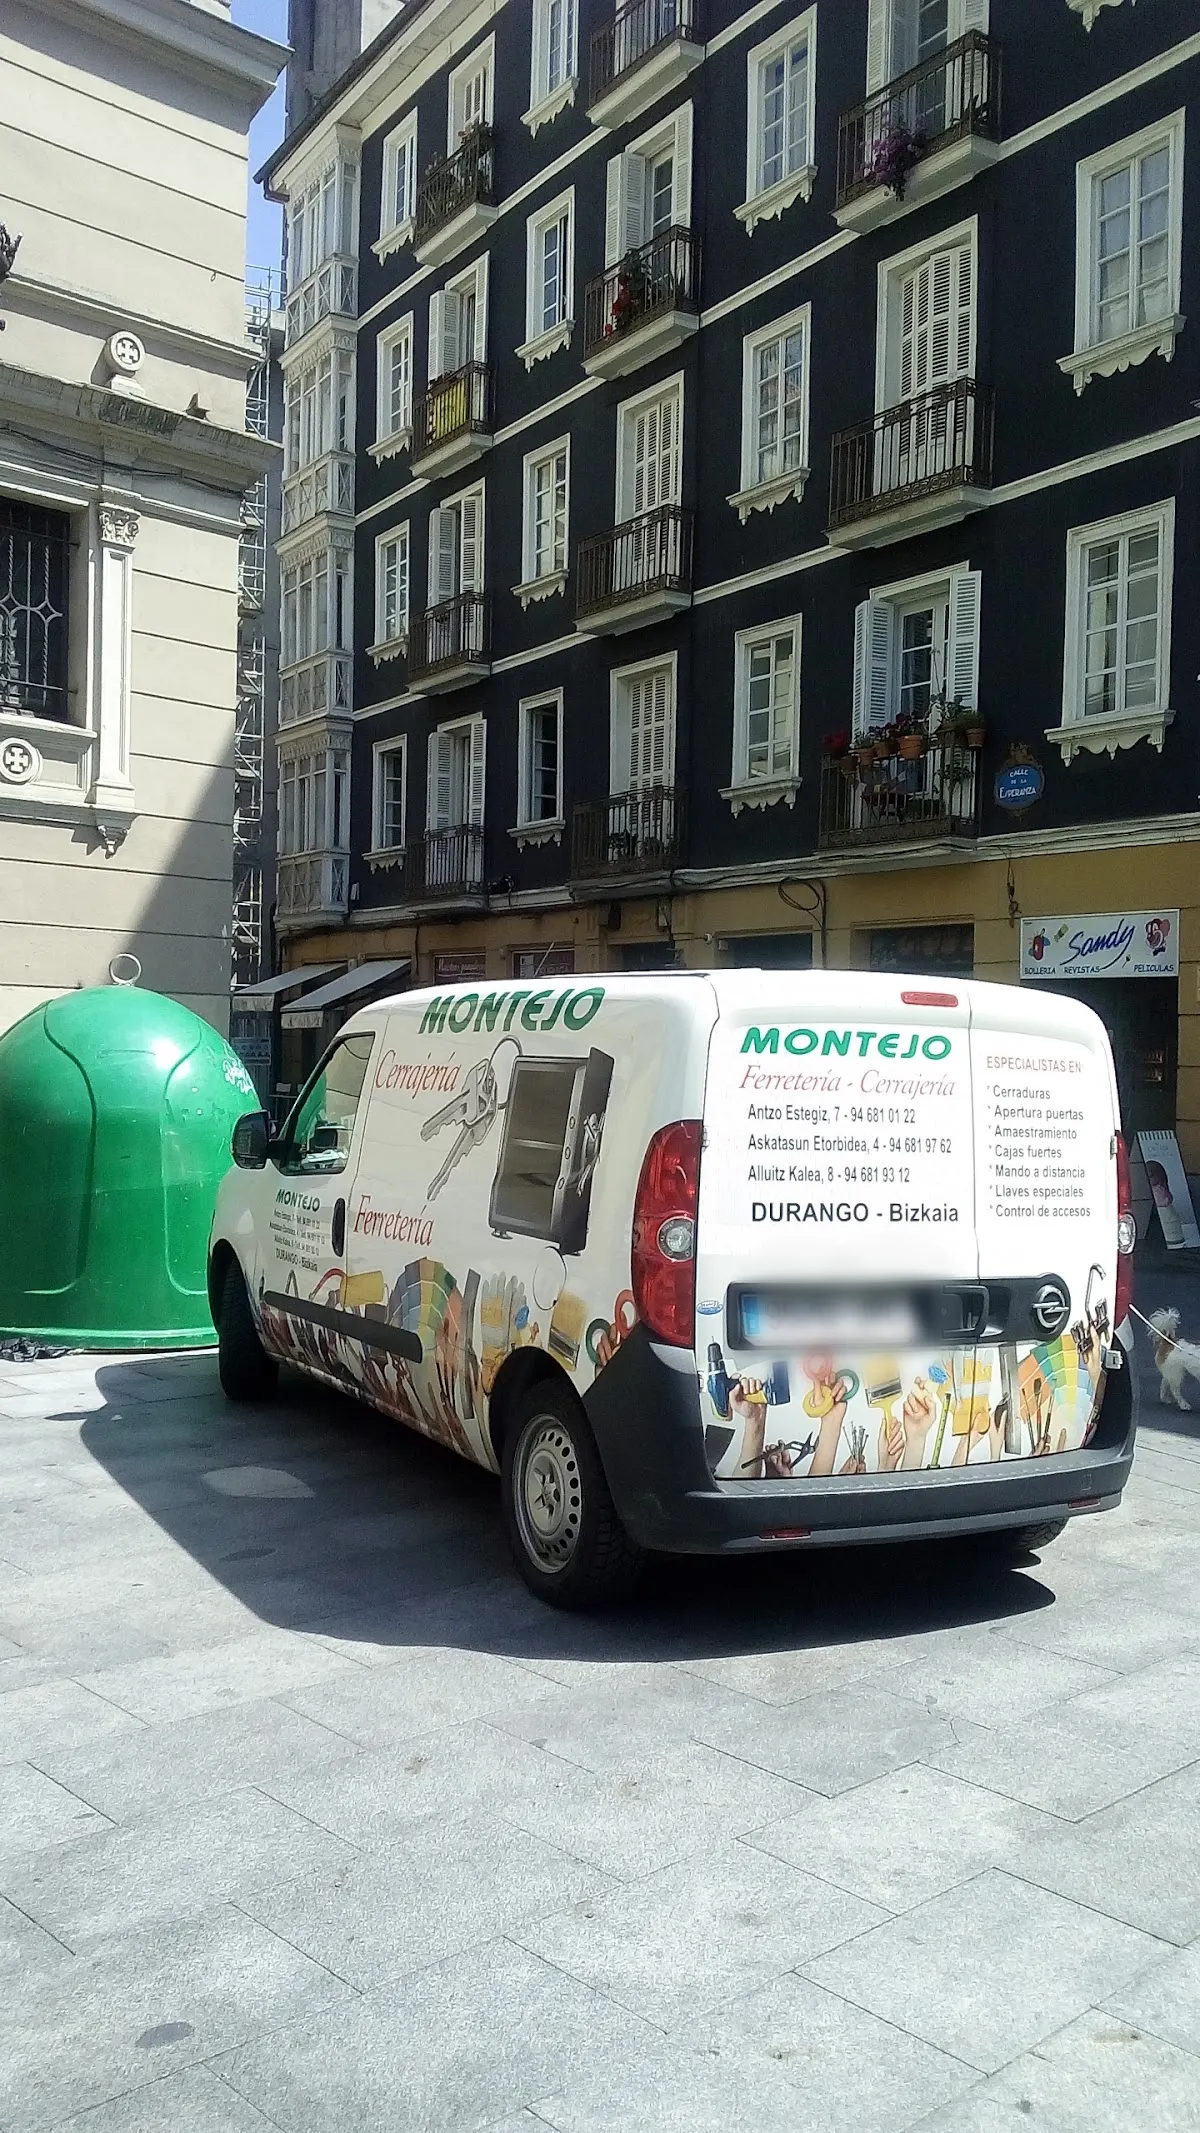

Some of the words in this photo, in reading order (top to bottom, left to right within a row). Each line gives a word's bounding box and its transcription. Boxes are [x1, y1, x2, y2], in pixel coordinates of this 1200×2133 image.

[1010, 769, 1028, 777] CALLE
[1000, 786, 1037, 799] ESPERANZA
[1060, 918, 1136, 970] Sandy
[1024, 967, 1056, 975] BOLLERIA
[1064, 964, 1100, 974] REVISTAS
[1134, 964, 1174, 973] PELICULAS
[418, 987, 606, 1034] MONTEJO
[740, 1027, 952, 1060] MONTEJO
[987, 1056, 1066, 1073] ESPECIALISTAS
[375, 1050, 462, 1099] Cerrajería
[739, 1064, 842, 1092] Ferretería
[860, 1069, 955, 1100] Cerrajería
[993, 1084, 1051, 1100] Cerraduras
[748, 1104, 782, 1120] Antzo
[786, 1105, 831, 1125] Estegiz,
[834, 1106, 840, 1121] 7
[850, 1107, 863, 1122] 94
[867, 1107, 884, 1123] 681
[888, 1108, 900, 1123] 01
[904, 1109, 916, 1124] 22
[994, 1104, 1042, 1120] Apertura
[1046, 1109, 1084, 1122] puertas
[995, 1124, 1077, 1139] Amaestramiento
[748, 1134, 809, 1150] Askatasun
[814, 1135, 870, 1154] Etorbidea,
[873, 1137, 879, 1150] 4
[889, 1137, 901, 1152] 94
[904, 1137, 922, 1153] 681
[925, 1138, 937, 1153] 97
[940, 1138, 952, 1153] 62
[995, 1144, 1024, 1160] Cajas
[1027, 1145, 1062, 1158] fuertes
[748, 1165, 785, 1181] Alluitz
[789, 1166, 824, 1184] Kalea,
[827, 1166, 834, 1181] 8
[844, 1166, 857, 1182] 94
[860, 1167, 878, 1182] 681
[882, 1167, 895, 1182] 93
[899, 1168, 910, 1182] 12
[995, 1164, 1030, 1177] Mando
[1034, 1168, 1039, 1177] a
[1043, 1165, 1085, 1178] distancia
[276, 1188, 320, 1212] MONTEJO
[996, 1184, 1029, 1197] Llaves
[1033, 1185, 1084, 1200] especiales
[752, 1202, 869, 1222] DURANGO
[890, 1203, 958, 1222] Bizkaia
[996, 1204, 1034, 1217] Control
[1038, 1205, 1049, 1217] de
[1053, 1208, 1091, 1217] accesos
[353, 1195, 435, 1246] Ferretería
[275, 1248, 298, 1265] DURANGO
